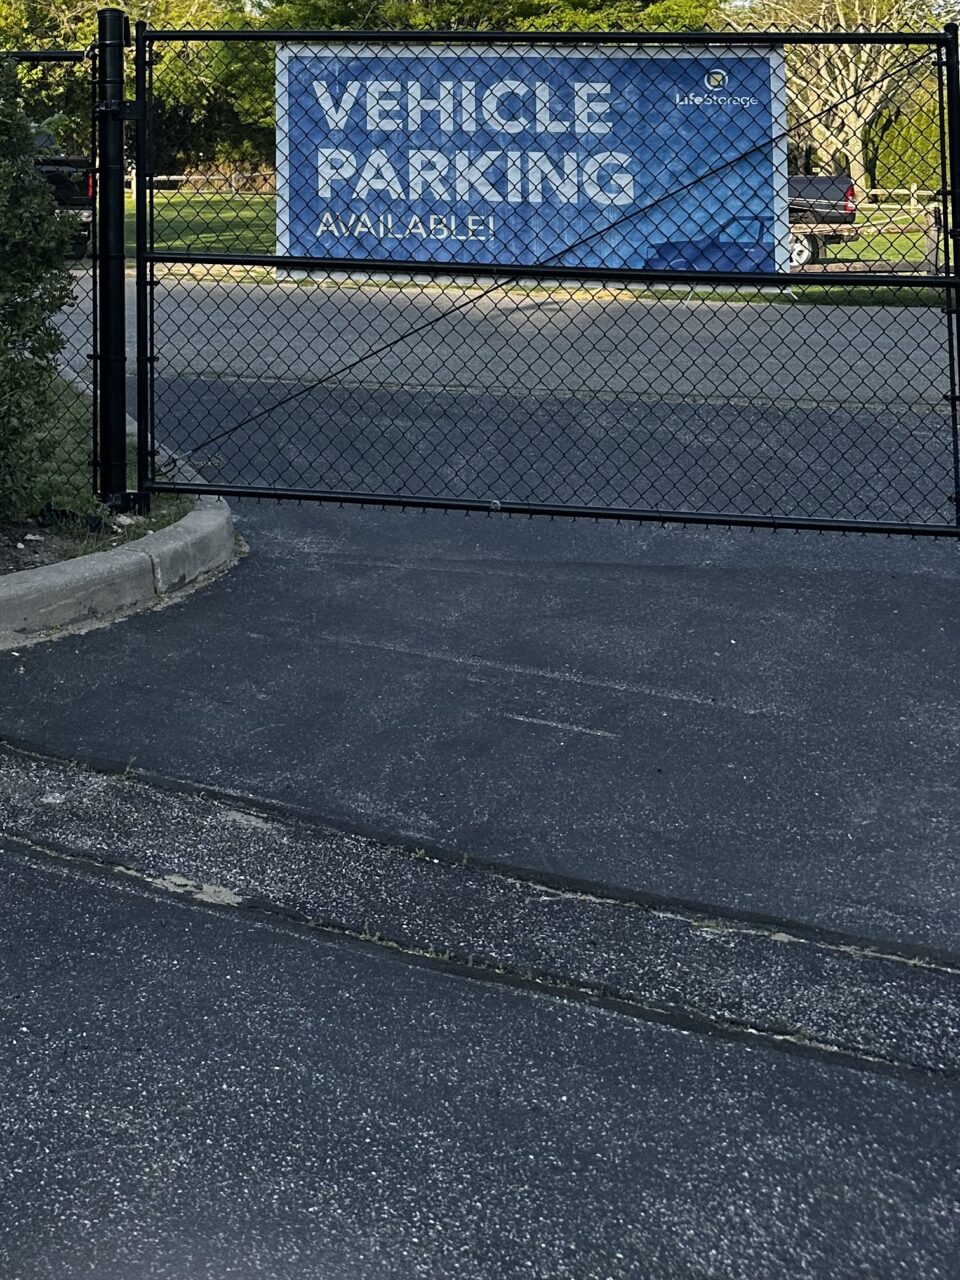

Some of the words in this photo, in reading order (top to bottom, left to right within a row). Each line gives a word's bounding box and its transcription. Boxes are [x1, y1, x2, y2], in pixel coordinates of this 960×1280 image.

[313, 81, 613, 134] VEHICLE
[317, 149, 636, 205] PARKING
[316, 212, 495, 241] AVAILABLE!
